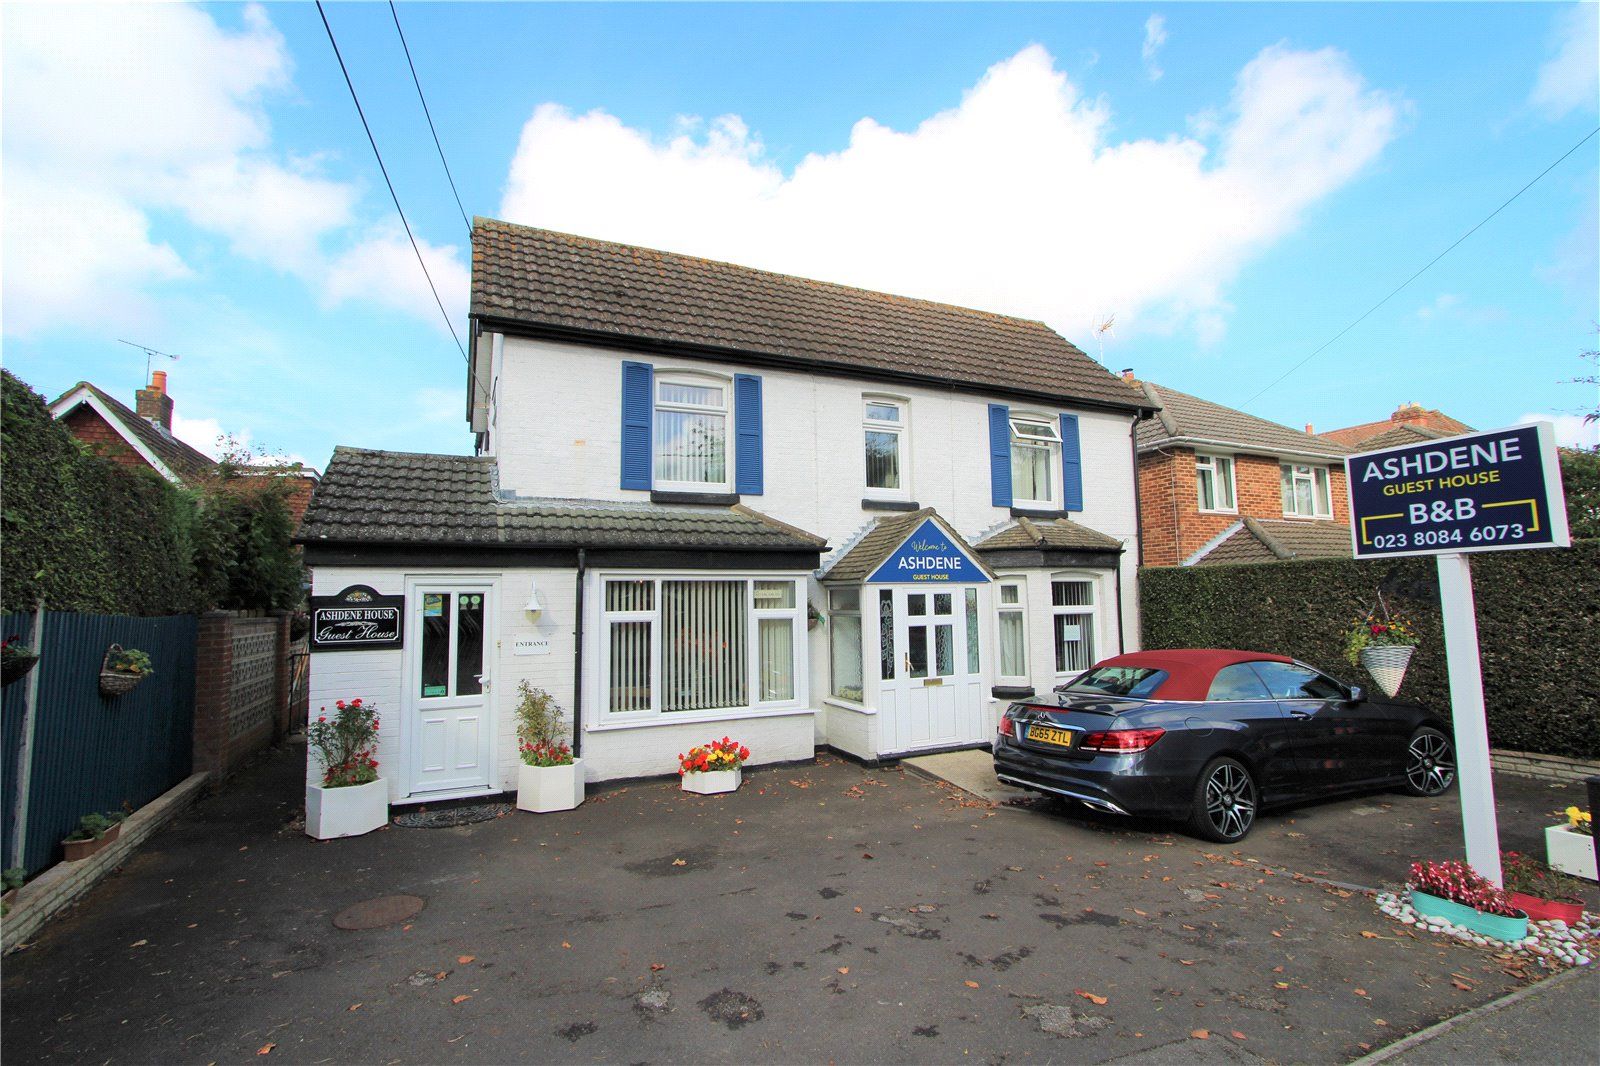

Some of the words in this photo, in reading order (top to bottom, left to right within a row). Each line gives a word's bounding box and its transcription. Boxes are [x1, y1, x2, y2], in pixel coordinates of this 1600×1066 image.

[1362, 437, 1523, 482] ASHDENE
[1383, 479, 1434, 496] GUEST
[1439, 470, 1501, 489] HOUSE
[1408, 497, 1477, 525] B&B
[1374, 533, 1408, 549] 023
[1413, 528, 1463, 546] 8084
[1469, 523, 1524, 542] 6073
[911, 539, 940, 553] Welcome
[940, 541, 948, 552] to
[898, 556, 962, 570] ASHDENE
[320, 610, 362, 621] ASHDENE
[364, 609, 395, 620] HOUSE
[318, 625, 353, 640] Guest
[355, 624, 395, 639] House
[1029, 726, 1050, 740] BG65
[1050, 730, 1069, 744] ZTL
